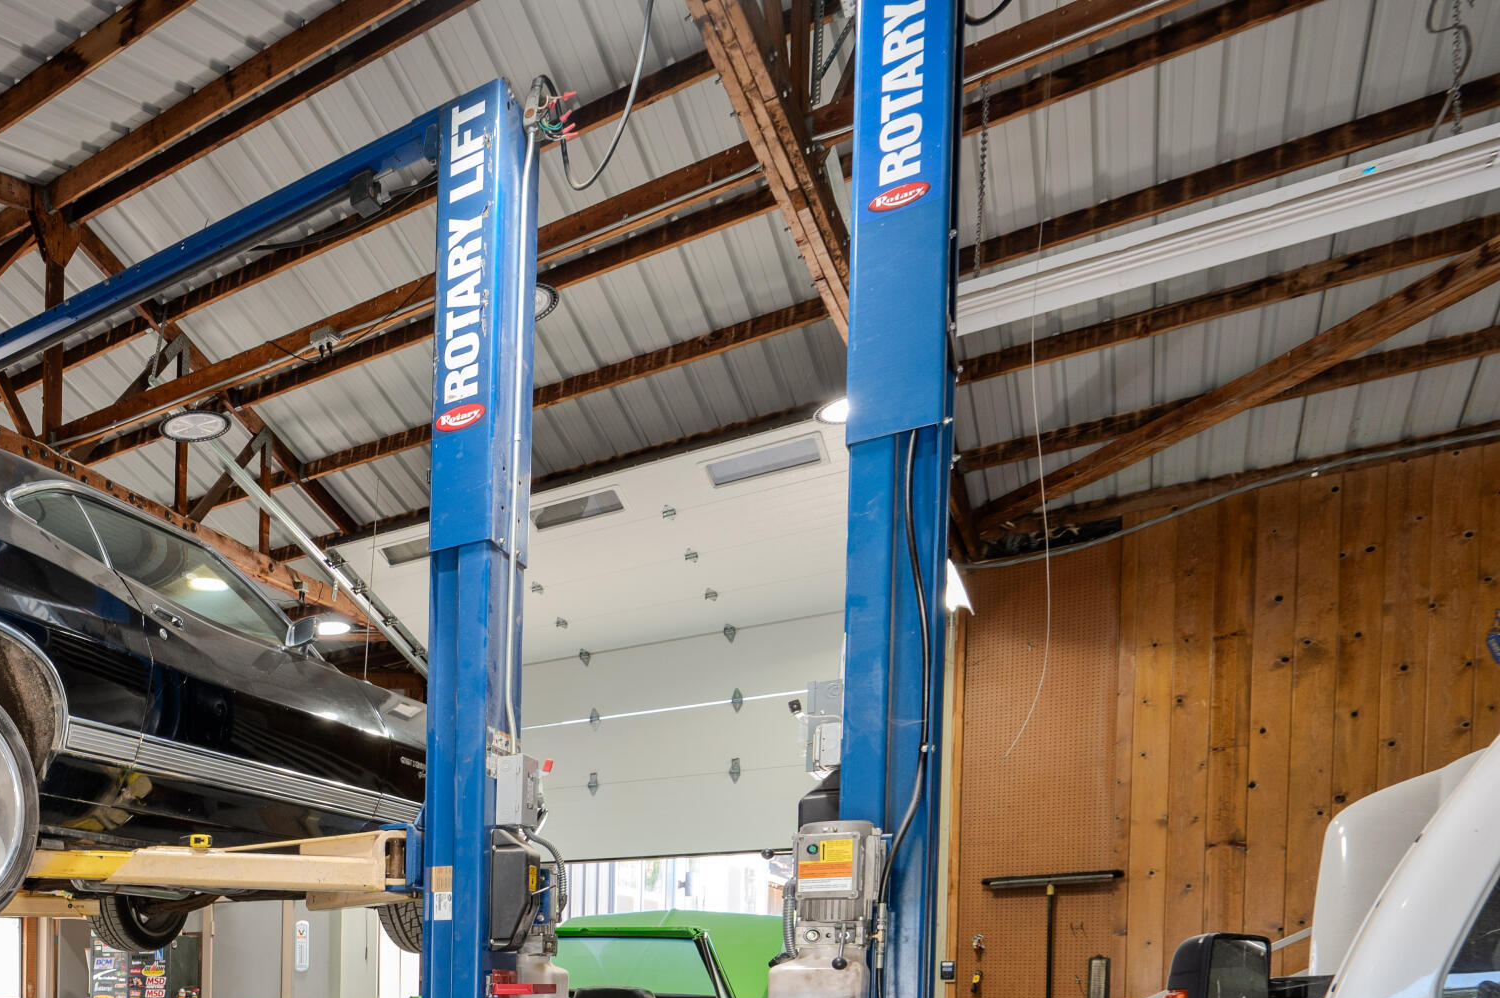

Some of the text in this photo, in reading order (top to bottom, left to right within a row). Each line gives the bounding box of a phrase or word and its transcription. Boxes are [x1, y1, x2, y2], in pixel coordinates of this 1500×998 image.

[879, 0, 926, 186] ROTARY
[875, 186, 924, 208] Rotary
[444, 99, 486, 404] ROTARY LIFT
[439, 406, 482, 428] Rotary
